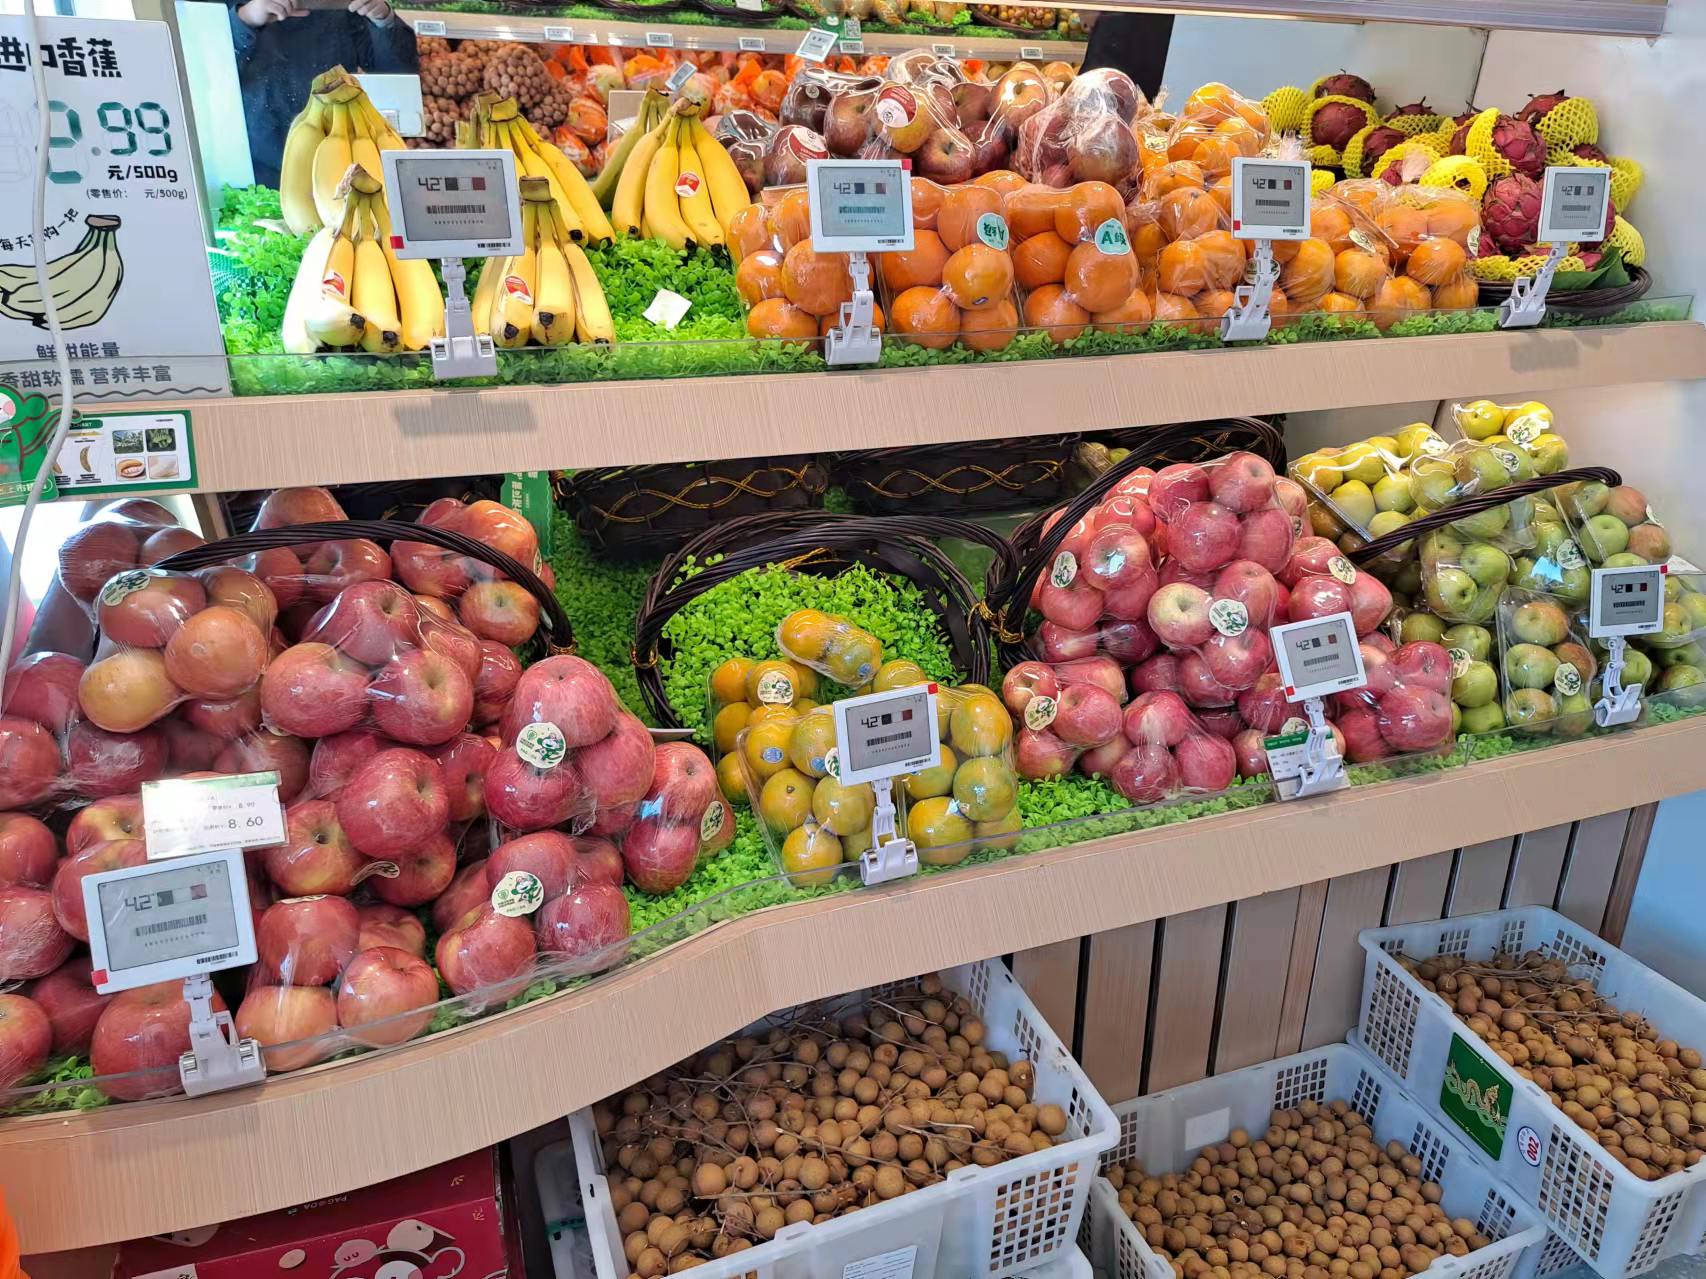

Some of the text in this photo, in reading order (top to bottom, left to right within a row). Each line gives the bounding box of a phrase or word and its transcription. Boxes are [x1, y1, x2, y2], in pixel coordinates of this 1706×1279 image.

[108, 165, 178, 183] 元/500g
[90, 365, 172, 385] 营养丰富
